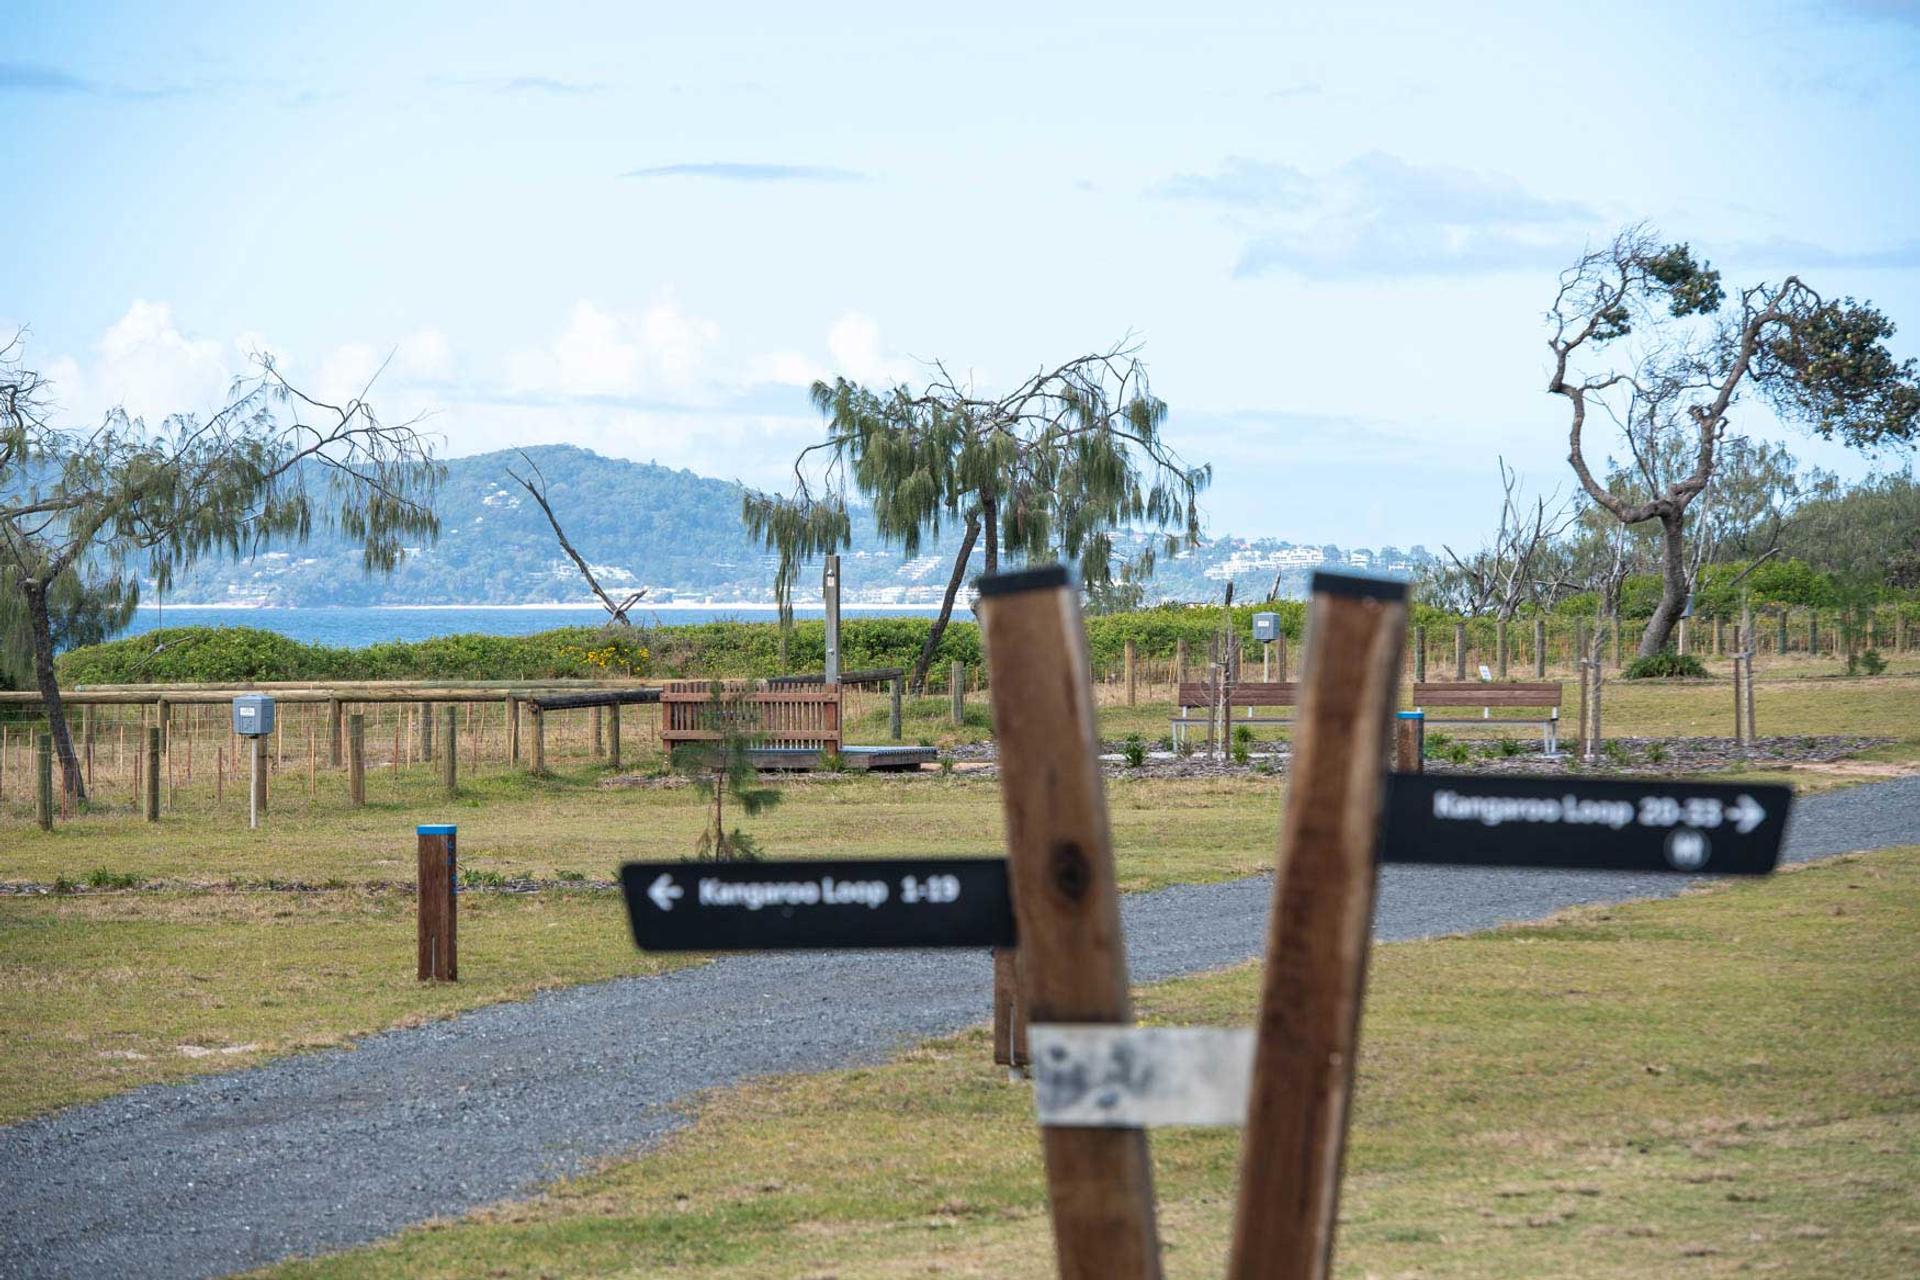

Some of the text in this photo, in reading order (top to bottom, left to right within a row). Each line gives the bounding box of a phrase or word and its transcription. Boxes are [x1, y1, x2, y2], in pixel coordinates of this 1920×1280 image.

[1434, 790, 1560, 825] Kangaroo
[1562, 794, 1633, 829] Loop
[699, 878, 820, 909] Kangaroo
[822, 876, 889, 908] Loop
